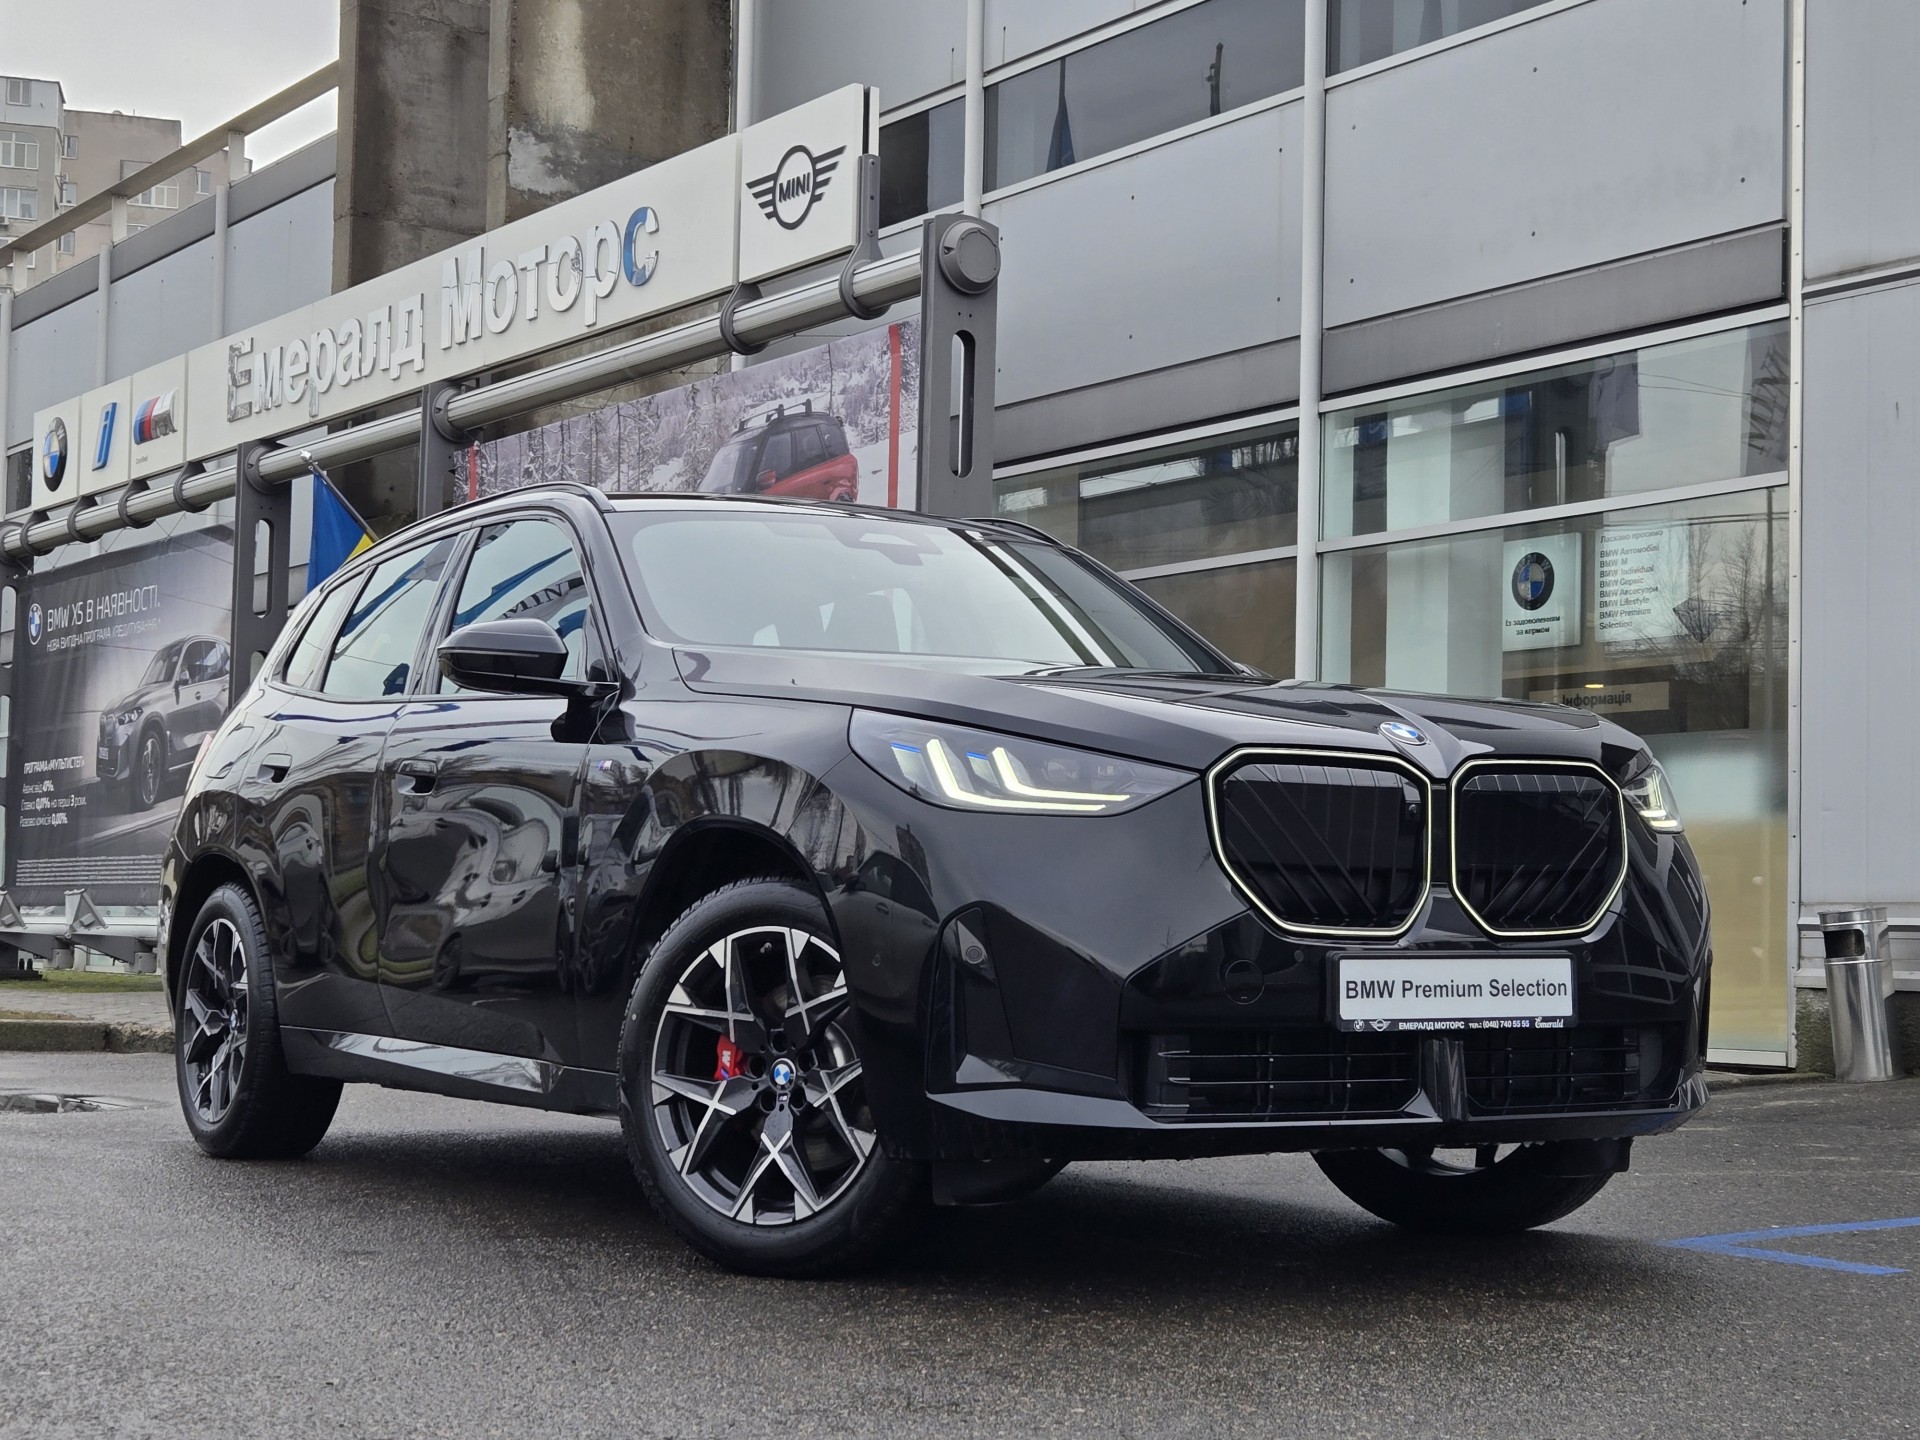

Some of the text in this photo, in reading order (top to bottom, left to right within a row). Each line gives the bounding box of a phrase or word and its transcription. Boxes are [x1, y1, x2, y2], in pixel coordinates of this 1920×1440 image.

[779, 172, 811, 203] MINI
[227, 206, 660, 422] Емералд Моторс
[1600, 548, 1618, 558] BMW
[1600, 559, 1618, 568] BMW
[1600, 569, 1618, 578] BMW
[1600, 579, 1618, 588] BMW
[1600, 589, 1618, 598] BMW
[47, 585, 161, 632] BMW X5 В НАЯВНОСТІ.
[1600, 599, 1618, 608] BMW
[1600, 608, 1651, 619] BMW Premium
[1600, 621, 1633, 630] Selection
[1562, 690, 1632, 708] Інформація
[1345, 978, 1568, 999] BMW Premium Selection
[1399, 1022, 1434, 1031] ЕМЕРАЛД
[1434, 1021, 1465, 1030] МОТОРС
[1500, 1020, 1512, 1028] 740
[1513, 1020, 1521, 1028] 55
[1521, 1020, 1530, 1028] 55
